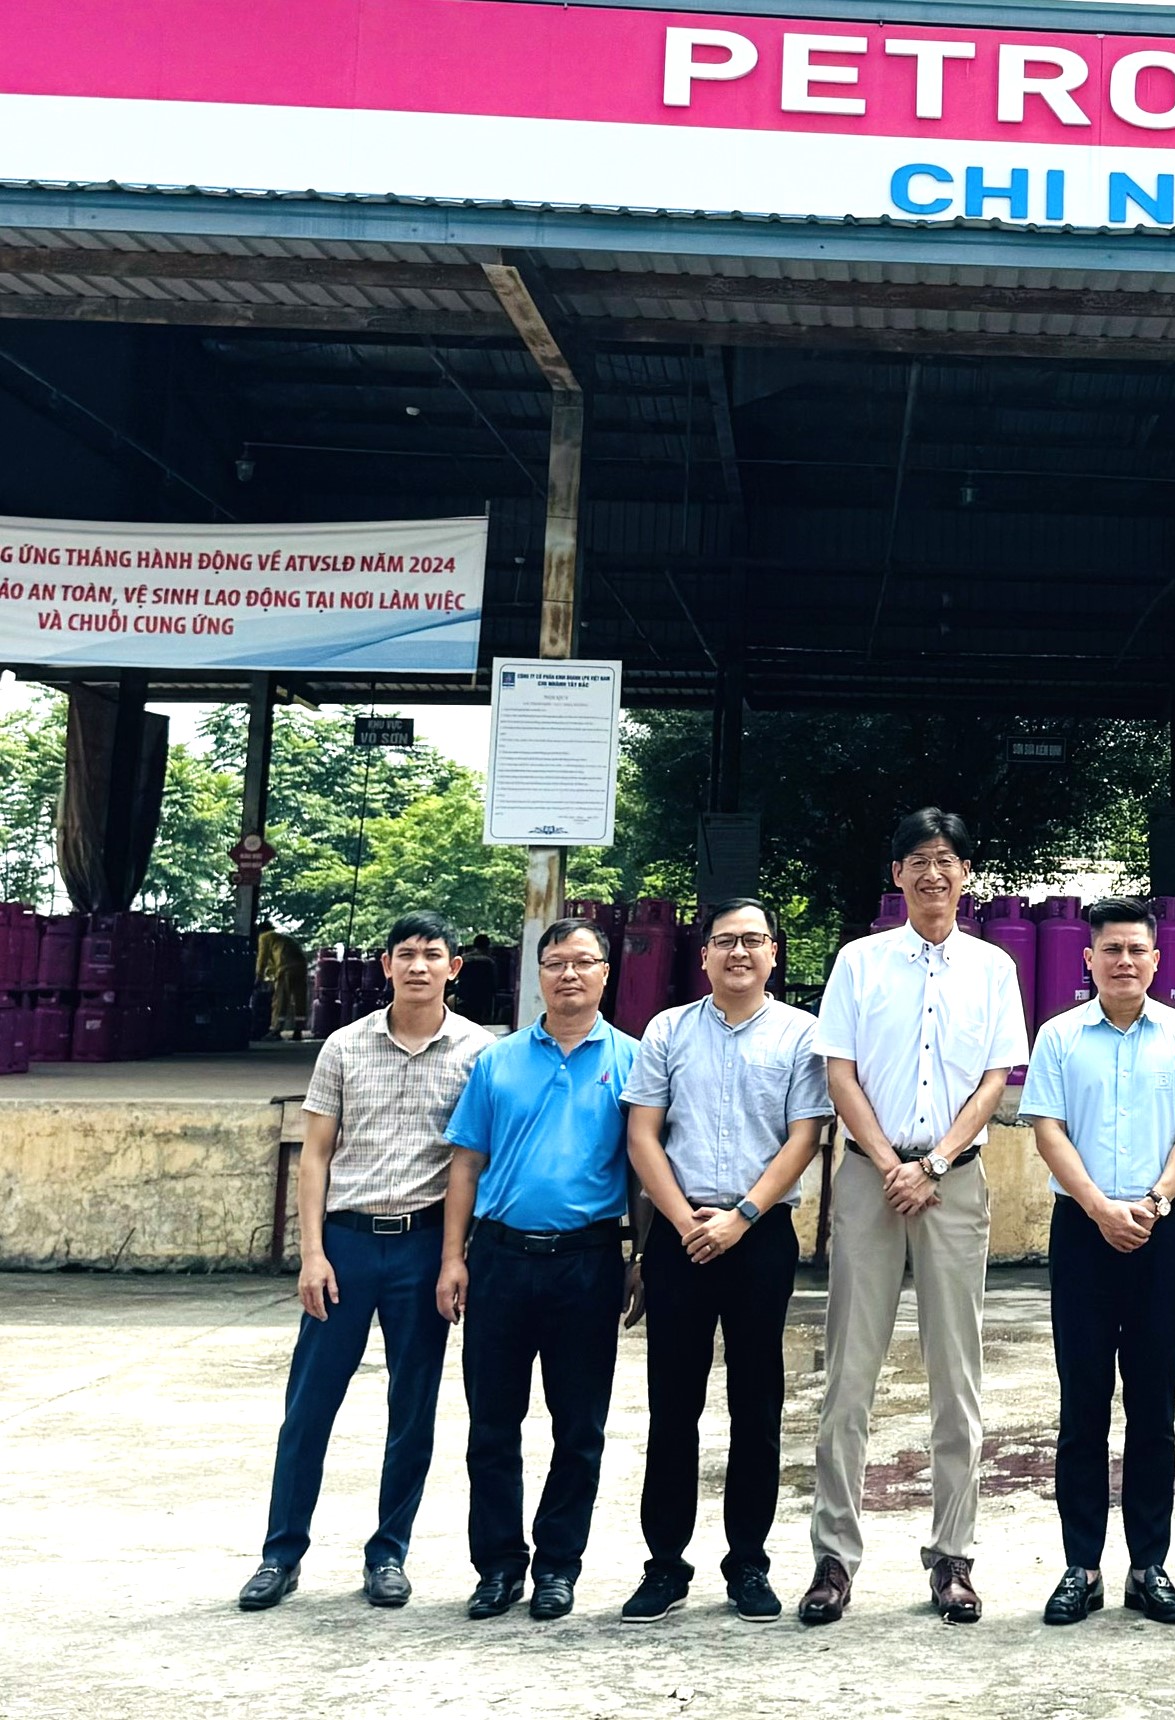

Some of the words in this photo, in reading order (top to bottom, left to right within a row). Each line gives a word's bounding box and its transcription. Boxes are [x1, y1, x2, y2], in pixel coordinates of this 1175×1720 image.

[889, 163, 1066, 221] CHI
[18, 544, 60, 565] ỨNG
[65, 547, 131, 567] THÁNG
[137, 548, 192, 569] HÀNH
[198, 550, 252, 574] ĐỘNG
[285, 555, 355, 571] ATVSLĐ
[360, 553, 404, 573] NĂM
[409, 556, 456, 573] 2024
[28, 583, 56, 600] AN
[62, 583, 118, 606] TOÀN,
[124, 585, 148, 609] VỆ
[152, 588, 199, 605] SINH
[204, 589, 241, 606] LAO
[245, 587, 300, 612] ĐỘNG
[306, 591, 334, 613] TẠI
[340, 590, 374, 609] NƠI
[379, 588, 419, 610] LÀM
[424, 590, 466, 615] VIỆC
[38, 609, 62, 630] VÀ
[68, 609, 128, 632] CHUỖI
[134, 616, 186, 635] CUNG
[193, 613, 234, 635] ỨNG
